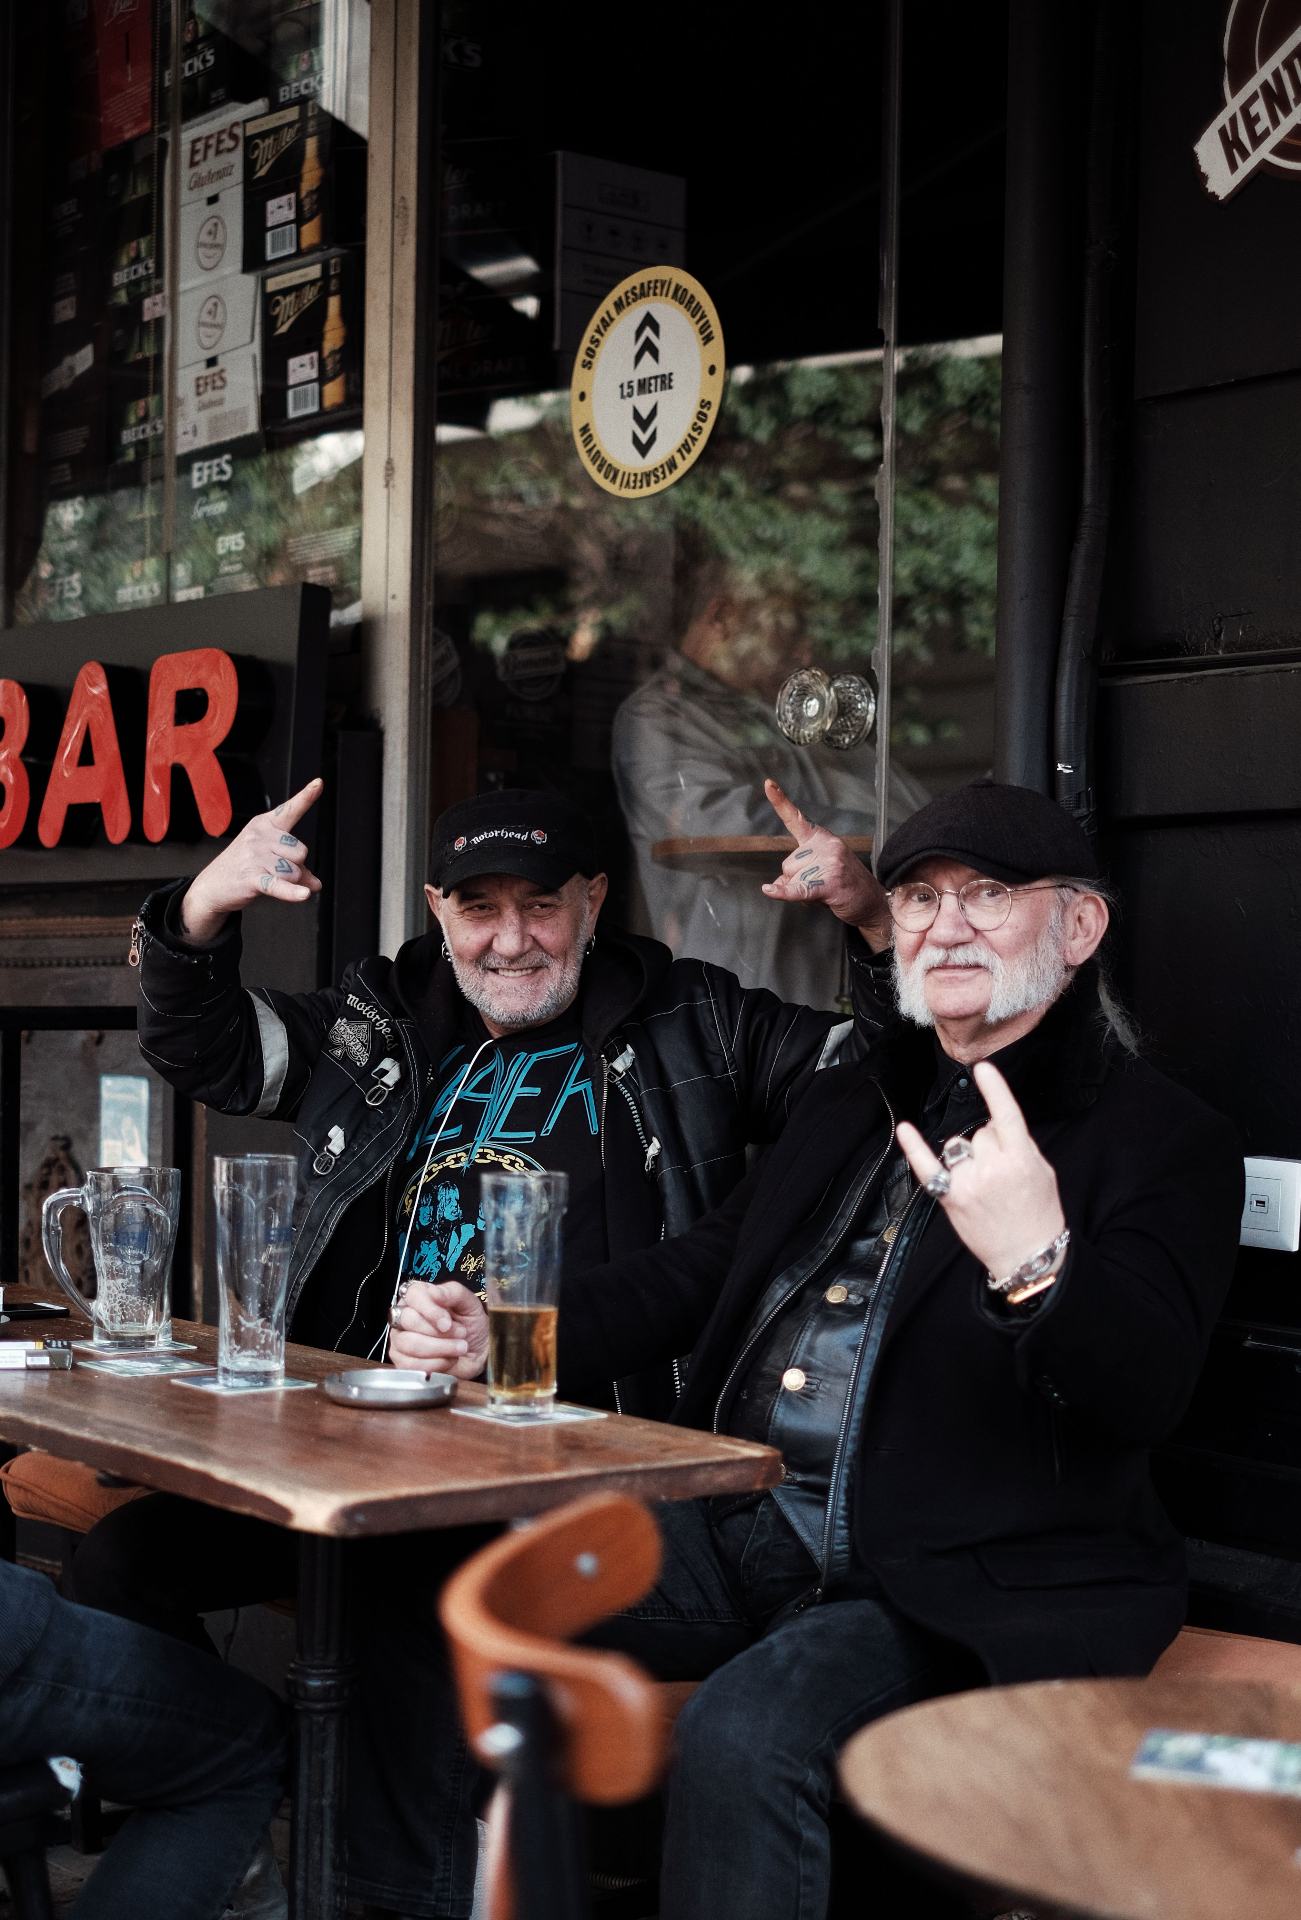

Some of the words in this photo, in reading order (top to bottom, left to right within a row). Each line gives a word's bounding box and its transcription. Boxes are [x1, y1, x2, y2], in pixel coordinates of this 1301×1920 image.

[189, 121, 240, 168] EFES
[582, 313, 616, 370] SOSYAL
[613, 278, 673, 313] MESAFEYİ
[671, 282, 715, 346] KORUYUN
[195, 369, 227, 396] EFES
[637, 372, 674, 396] METRE
[681, 398, 712, 460] SOSYAL
[191, 454, 232, 489] EFES
[579, 422, 618, 484] KORUYUN
